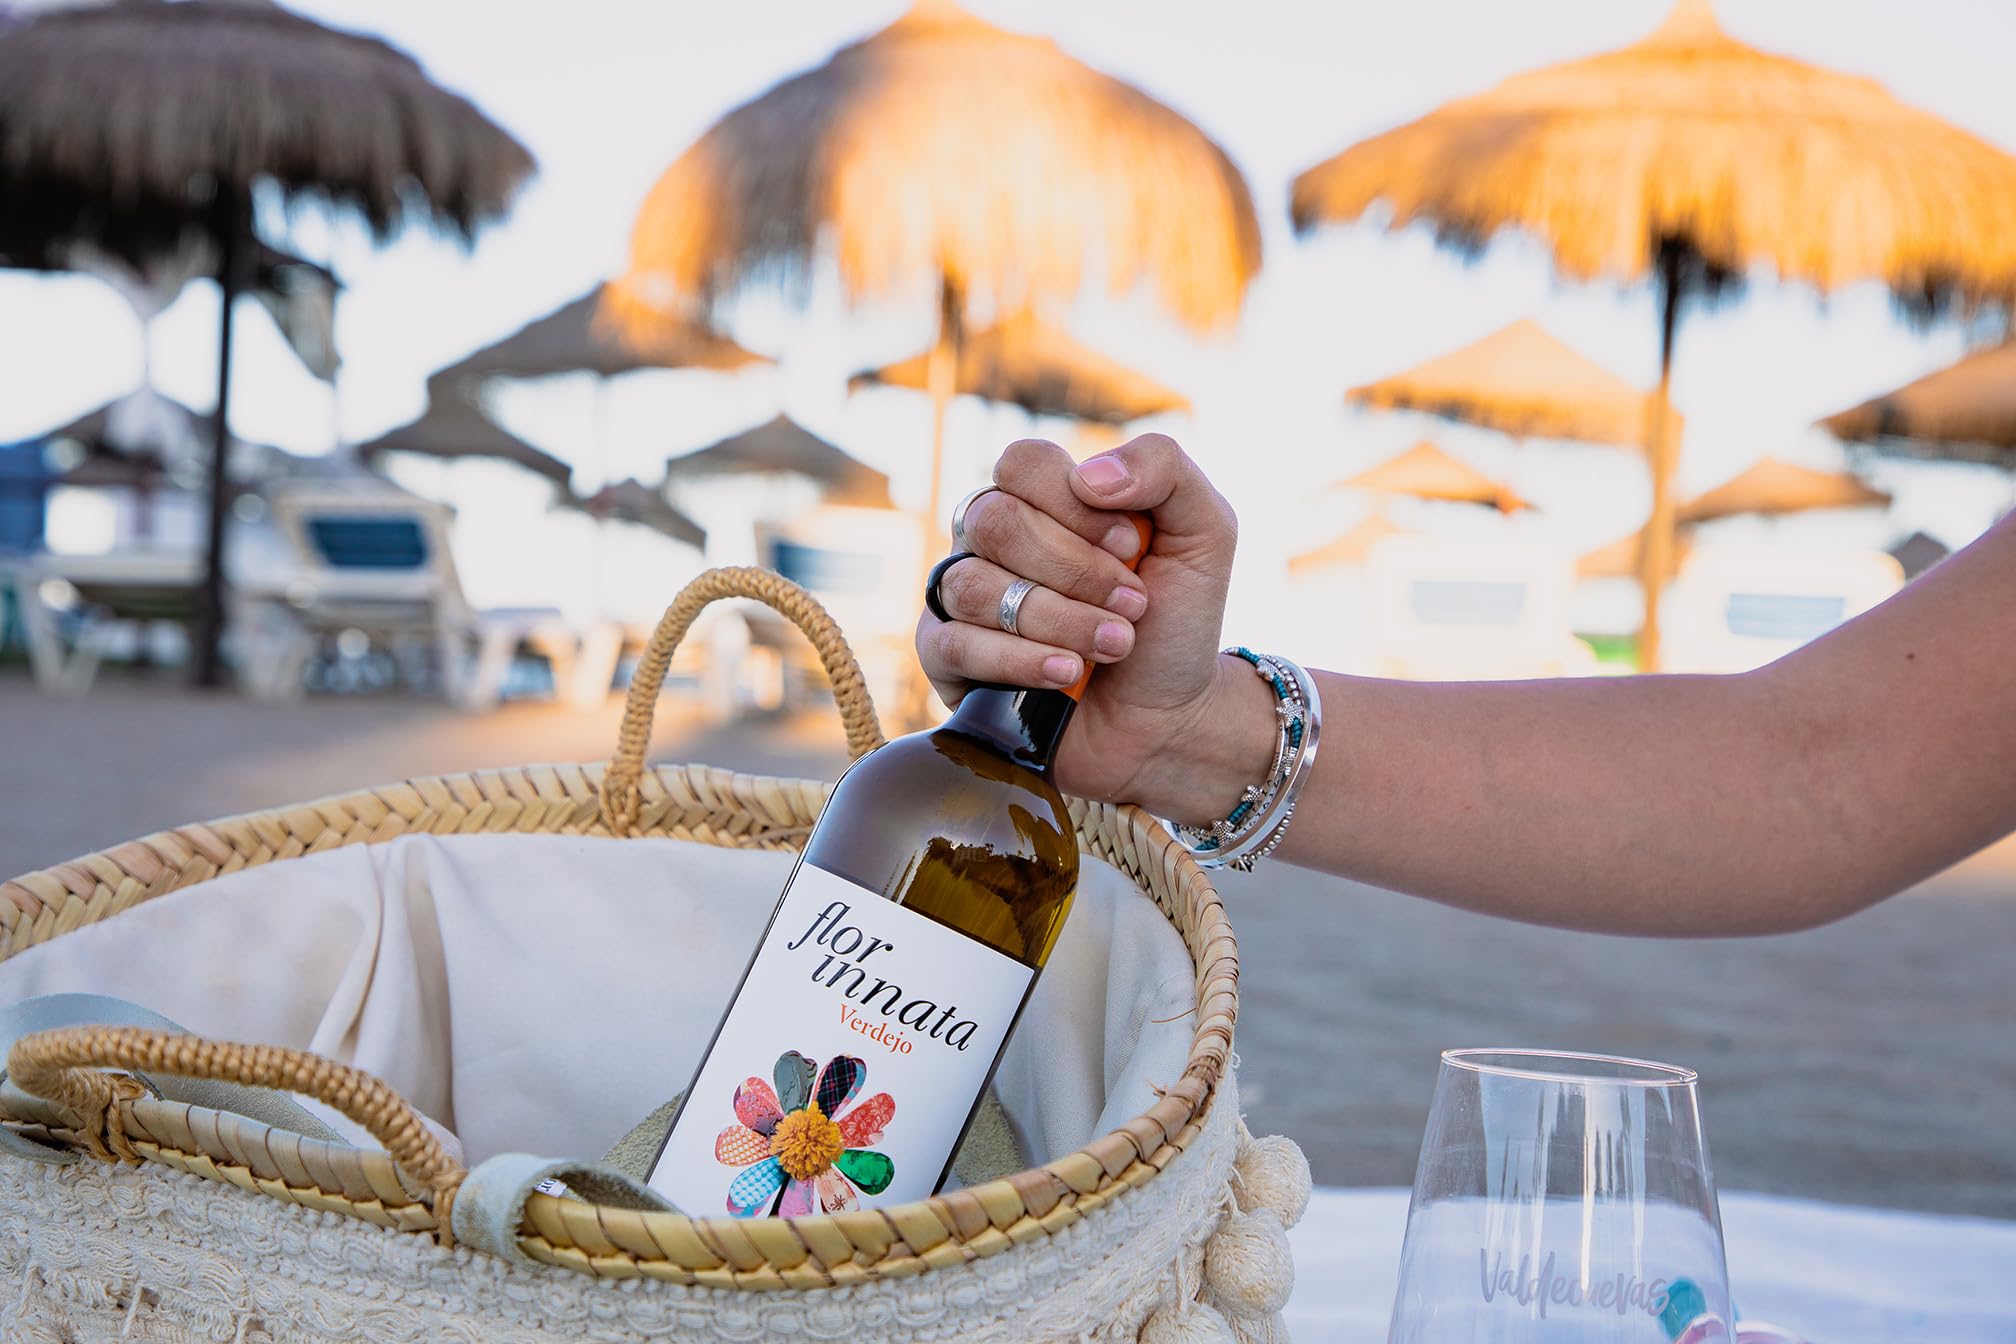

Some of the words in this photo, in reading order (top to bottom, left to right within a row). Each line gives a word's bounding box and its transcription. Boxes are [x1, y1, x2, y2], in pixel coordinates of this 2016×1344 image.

[787, 901, 894, 963] flor
[811, 953, 979, 1051] innata
[839, 1003, 913, 1055] Verdejo
[1480, 1247, 1671, 1321] Valdecuevas
